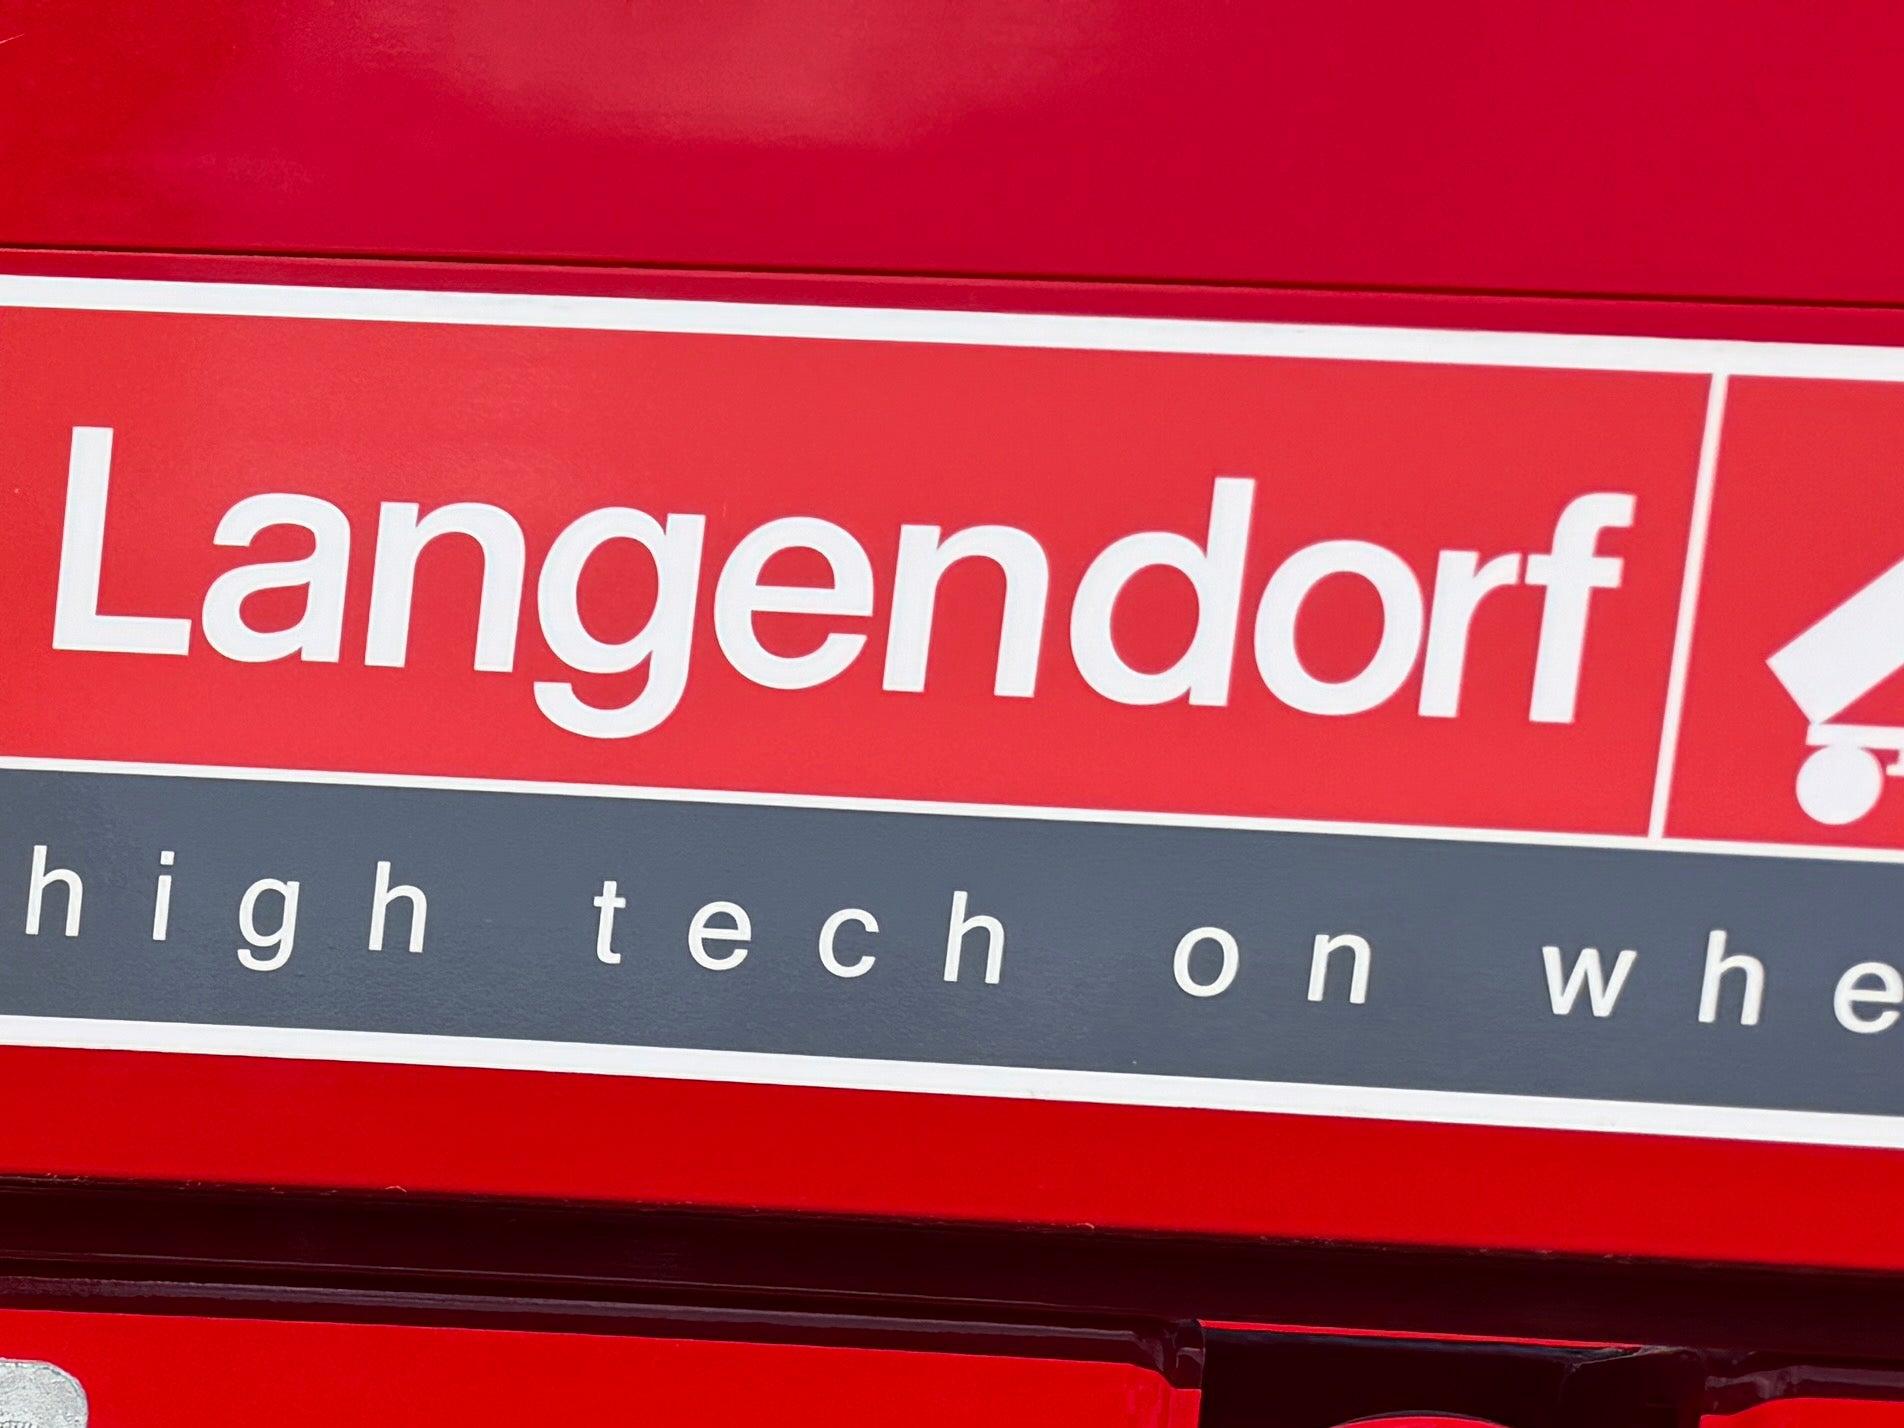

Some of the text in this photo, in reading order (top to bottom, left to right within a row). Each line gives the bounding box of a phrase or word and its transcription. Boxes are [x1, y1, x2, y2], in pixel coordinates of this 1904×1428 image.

[52, 426, 1635, 739] Langendorf
[25, 844, 1904, 1034] high tech on whe
